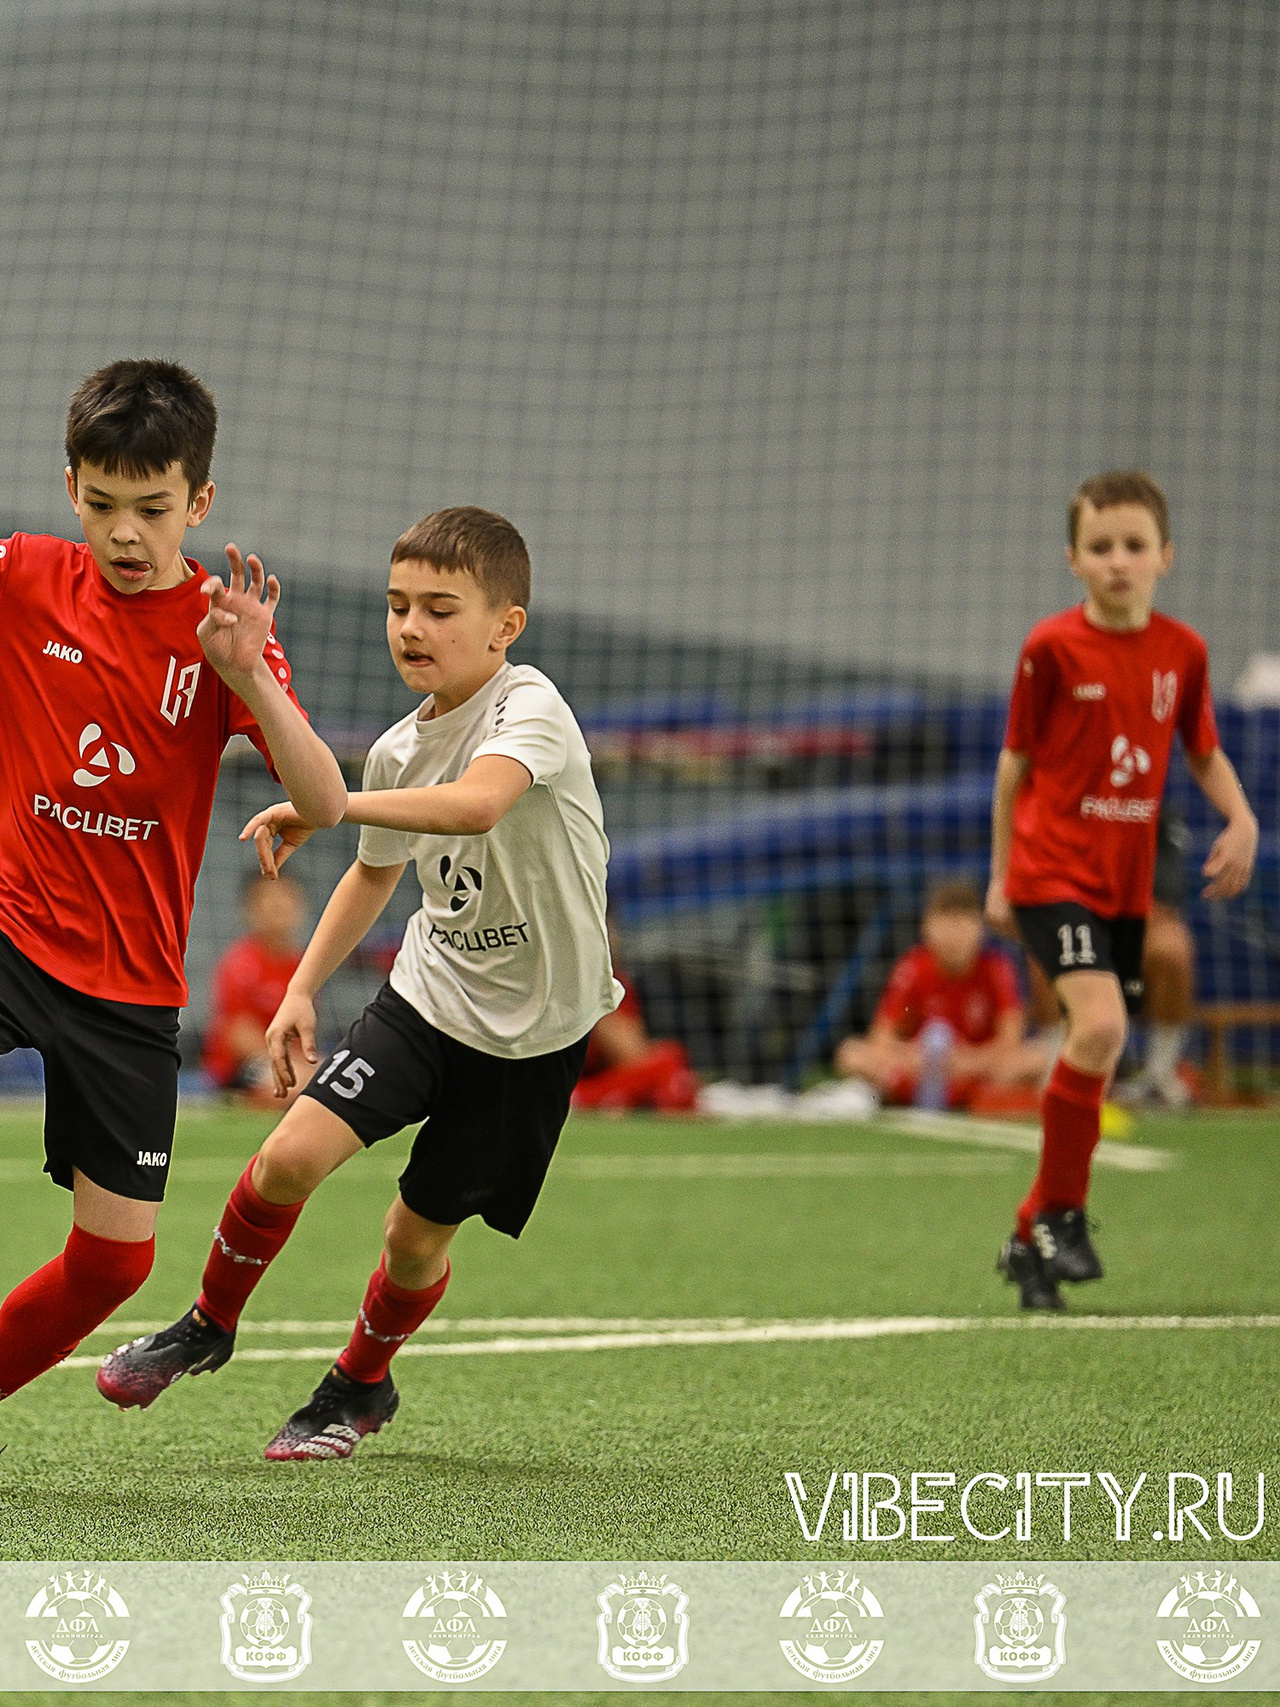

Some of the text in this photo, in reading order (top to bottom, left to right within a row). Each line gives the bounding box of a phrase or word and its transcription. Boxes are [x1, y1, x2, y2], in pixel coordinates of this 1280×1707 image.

[42, 640, 83, 664] JAKO
[34, 793, 159, 840] РАСЦВЕТ
[1057, 923, 1097, 966] 11
[317, 1049, 375, 1099] 15
[136, 1150, 168, 1167] JAKO
